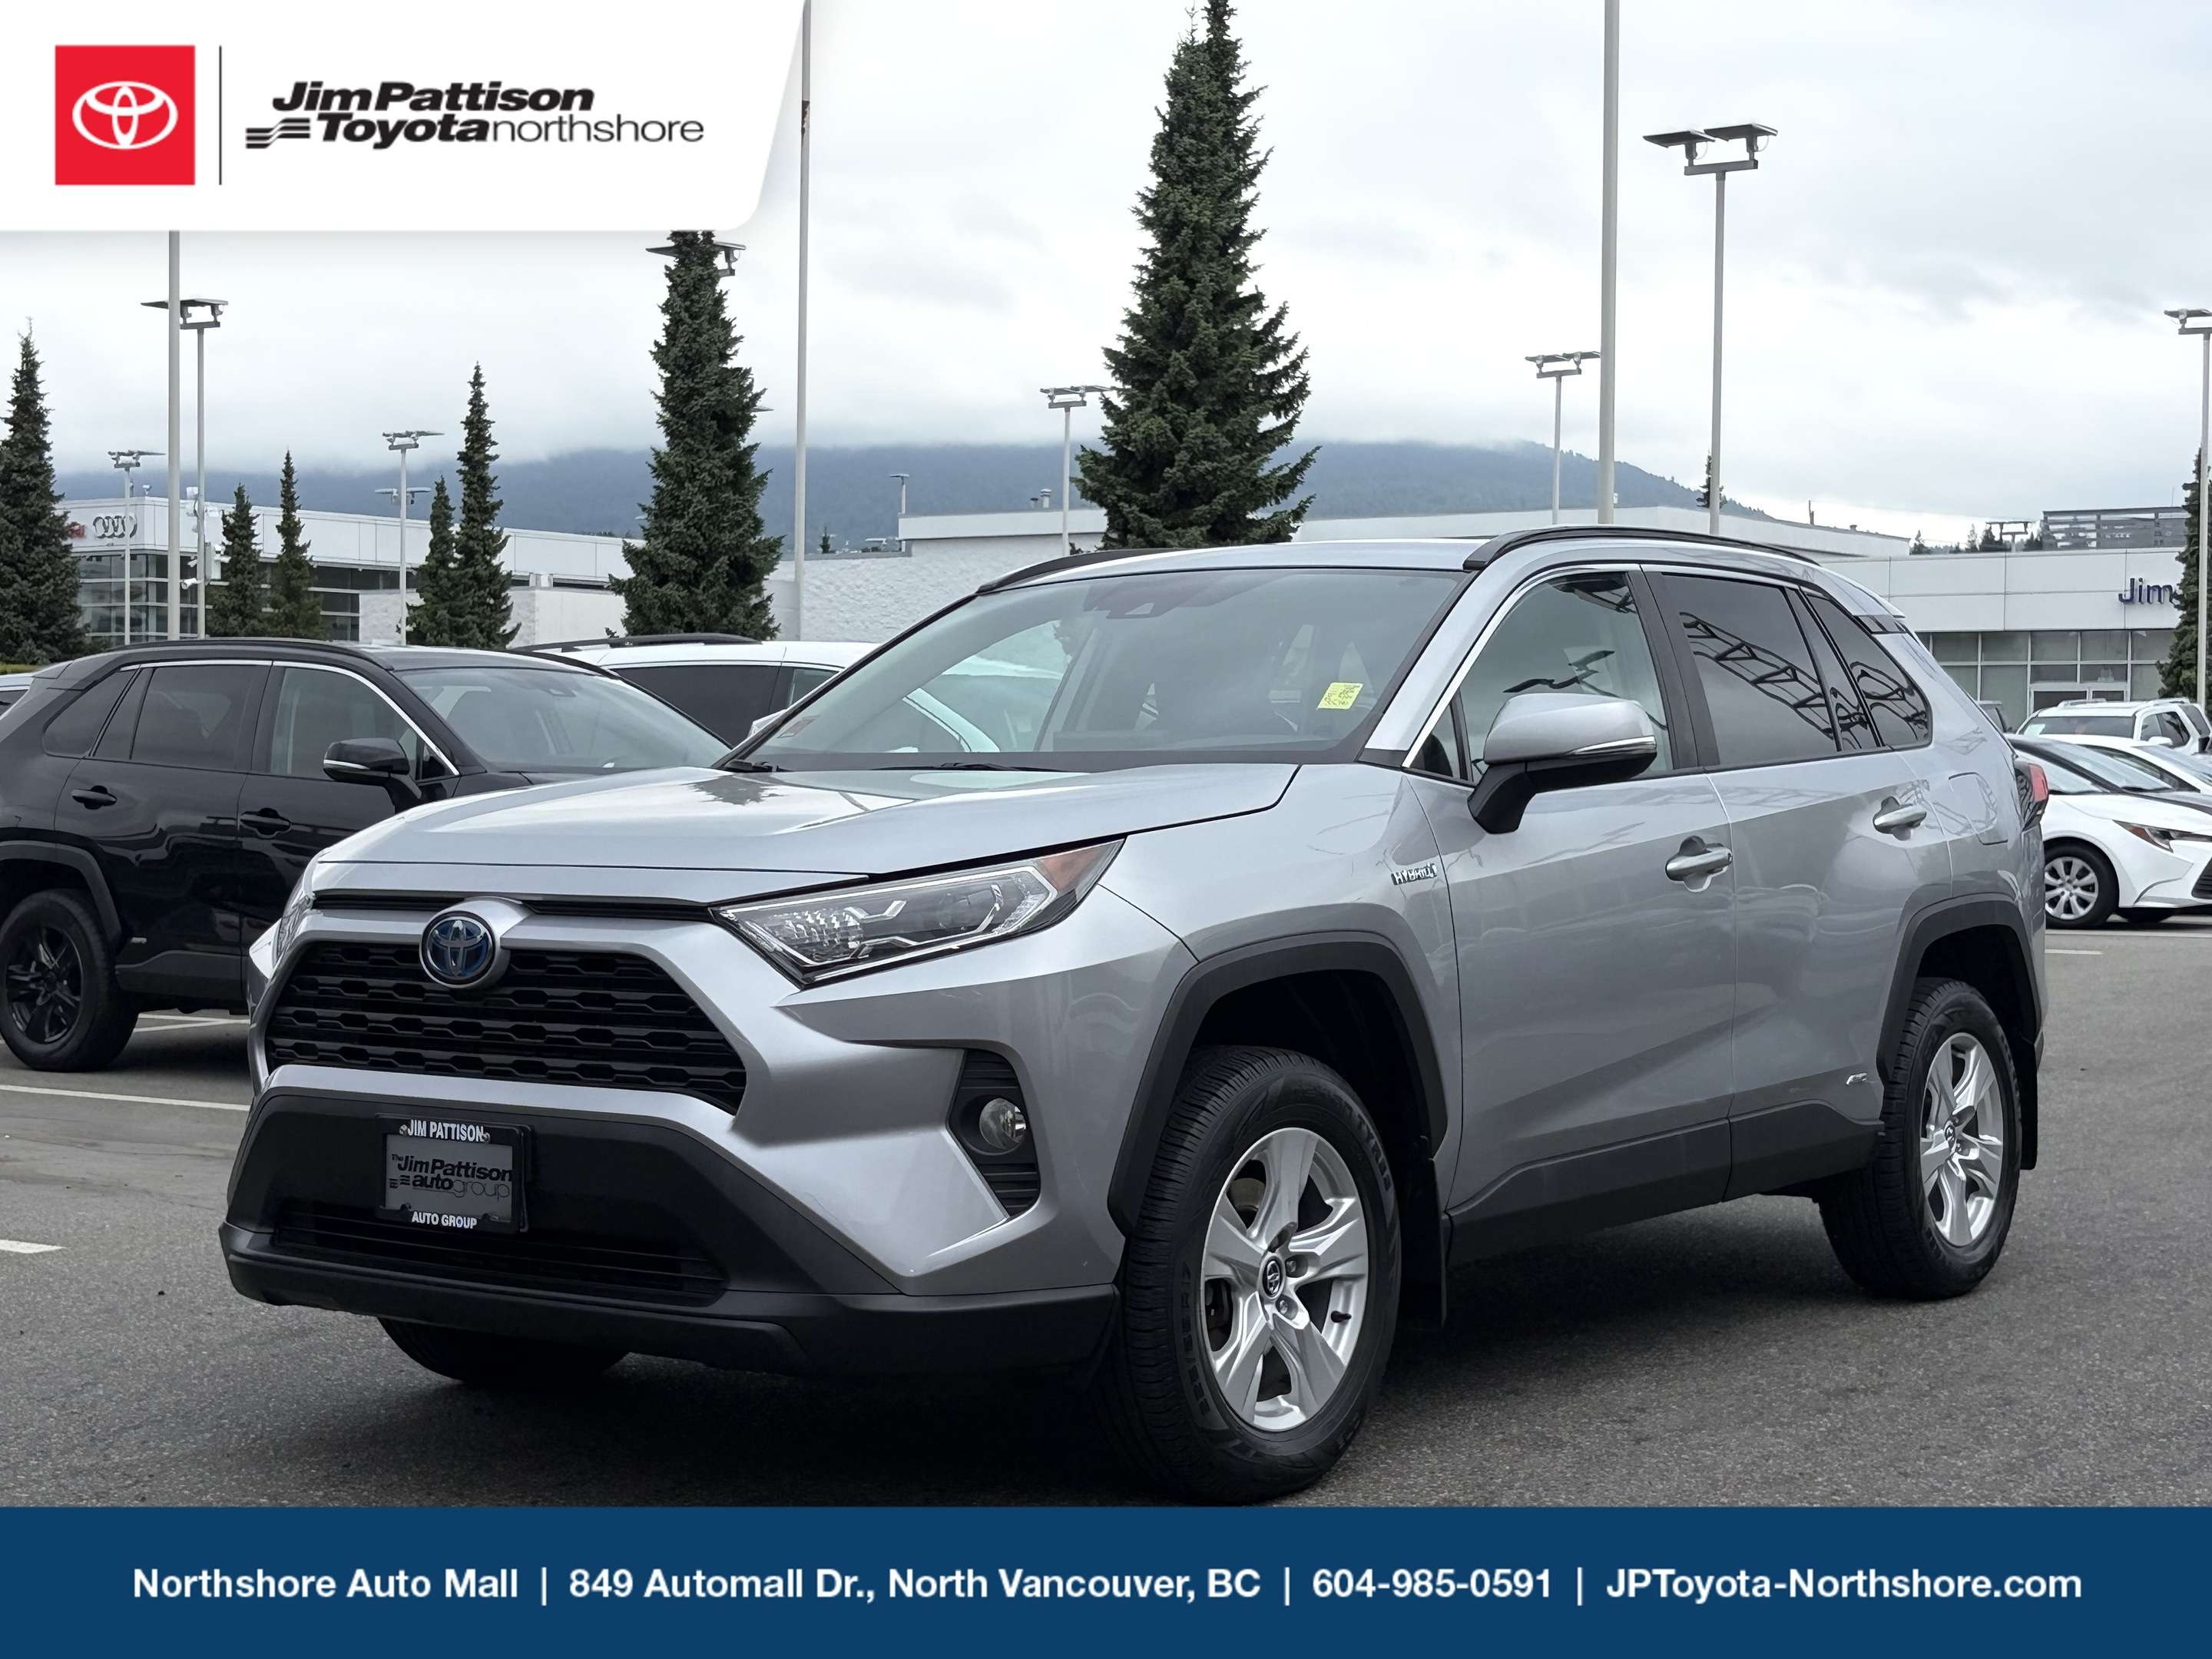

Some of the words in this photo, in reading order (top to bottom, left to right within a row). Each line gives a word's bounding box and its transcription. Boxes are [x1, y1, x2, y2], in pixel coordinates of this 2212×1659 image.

[2118, 578, 2173, 603] Jim
[407, 1119, 427, 1137] JIM
[429, 1121, 485, 1142] PATTISON
[398, 1155, 429, 1174] Jim
[431, 1159, 513, 1182] Pattison
[412, 1211, 439, 1225] AUTO
[441, 1214, 478, 1229] GROUP
